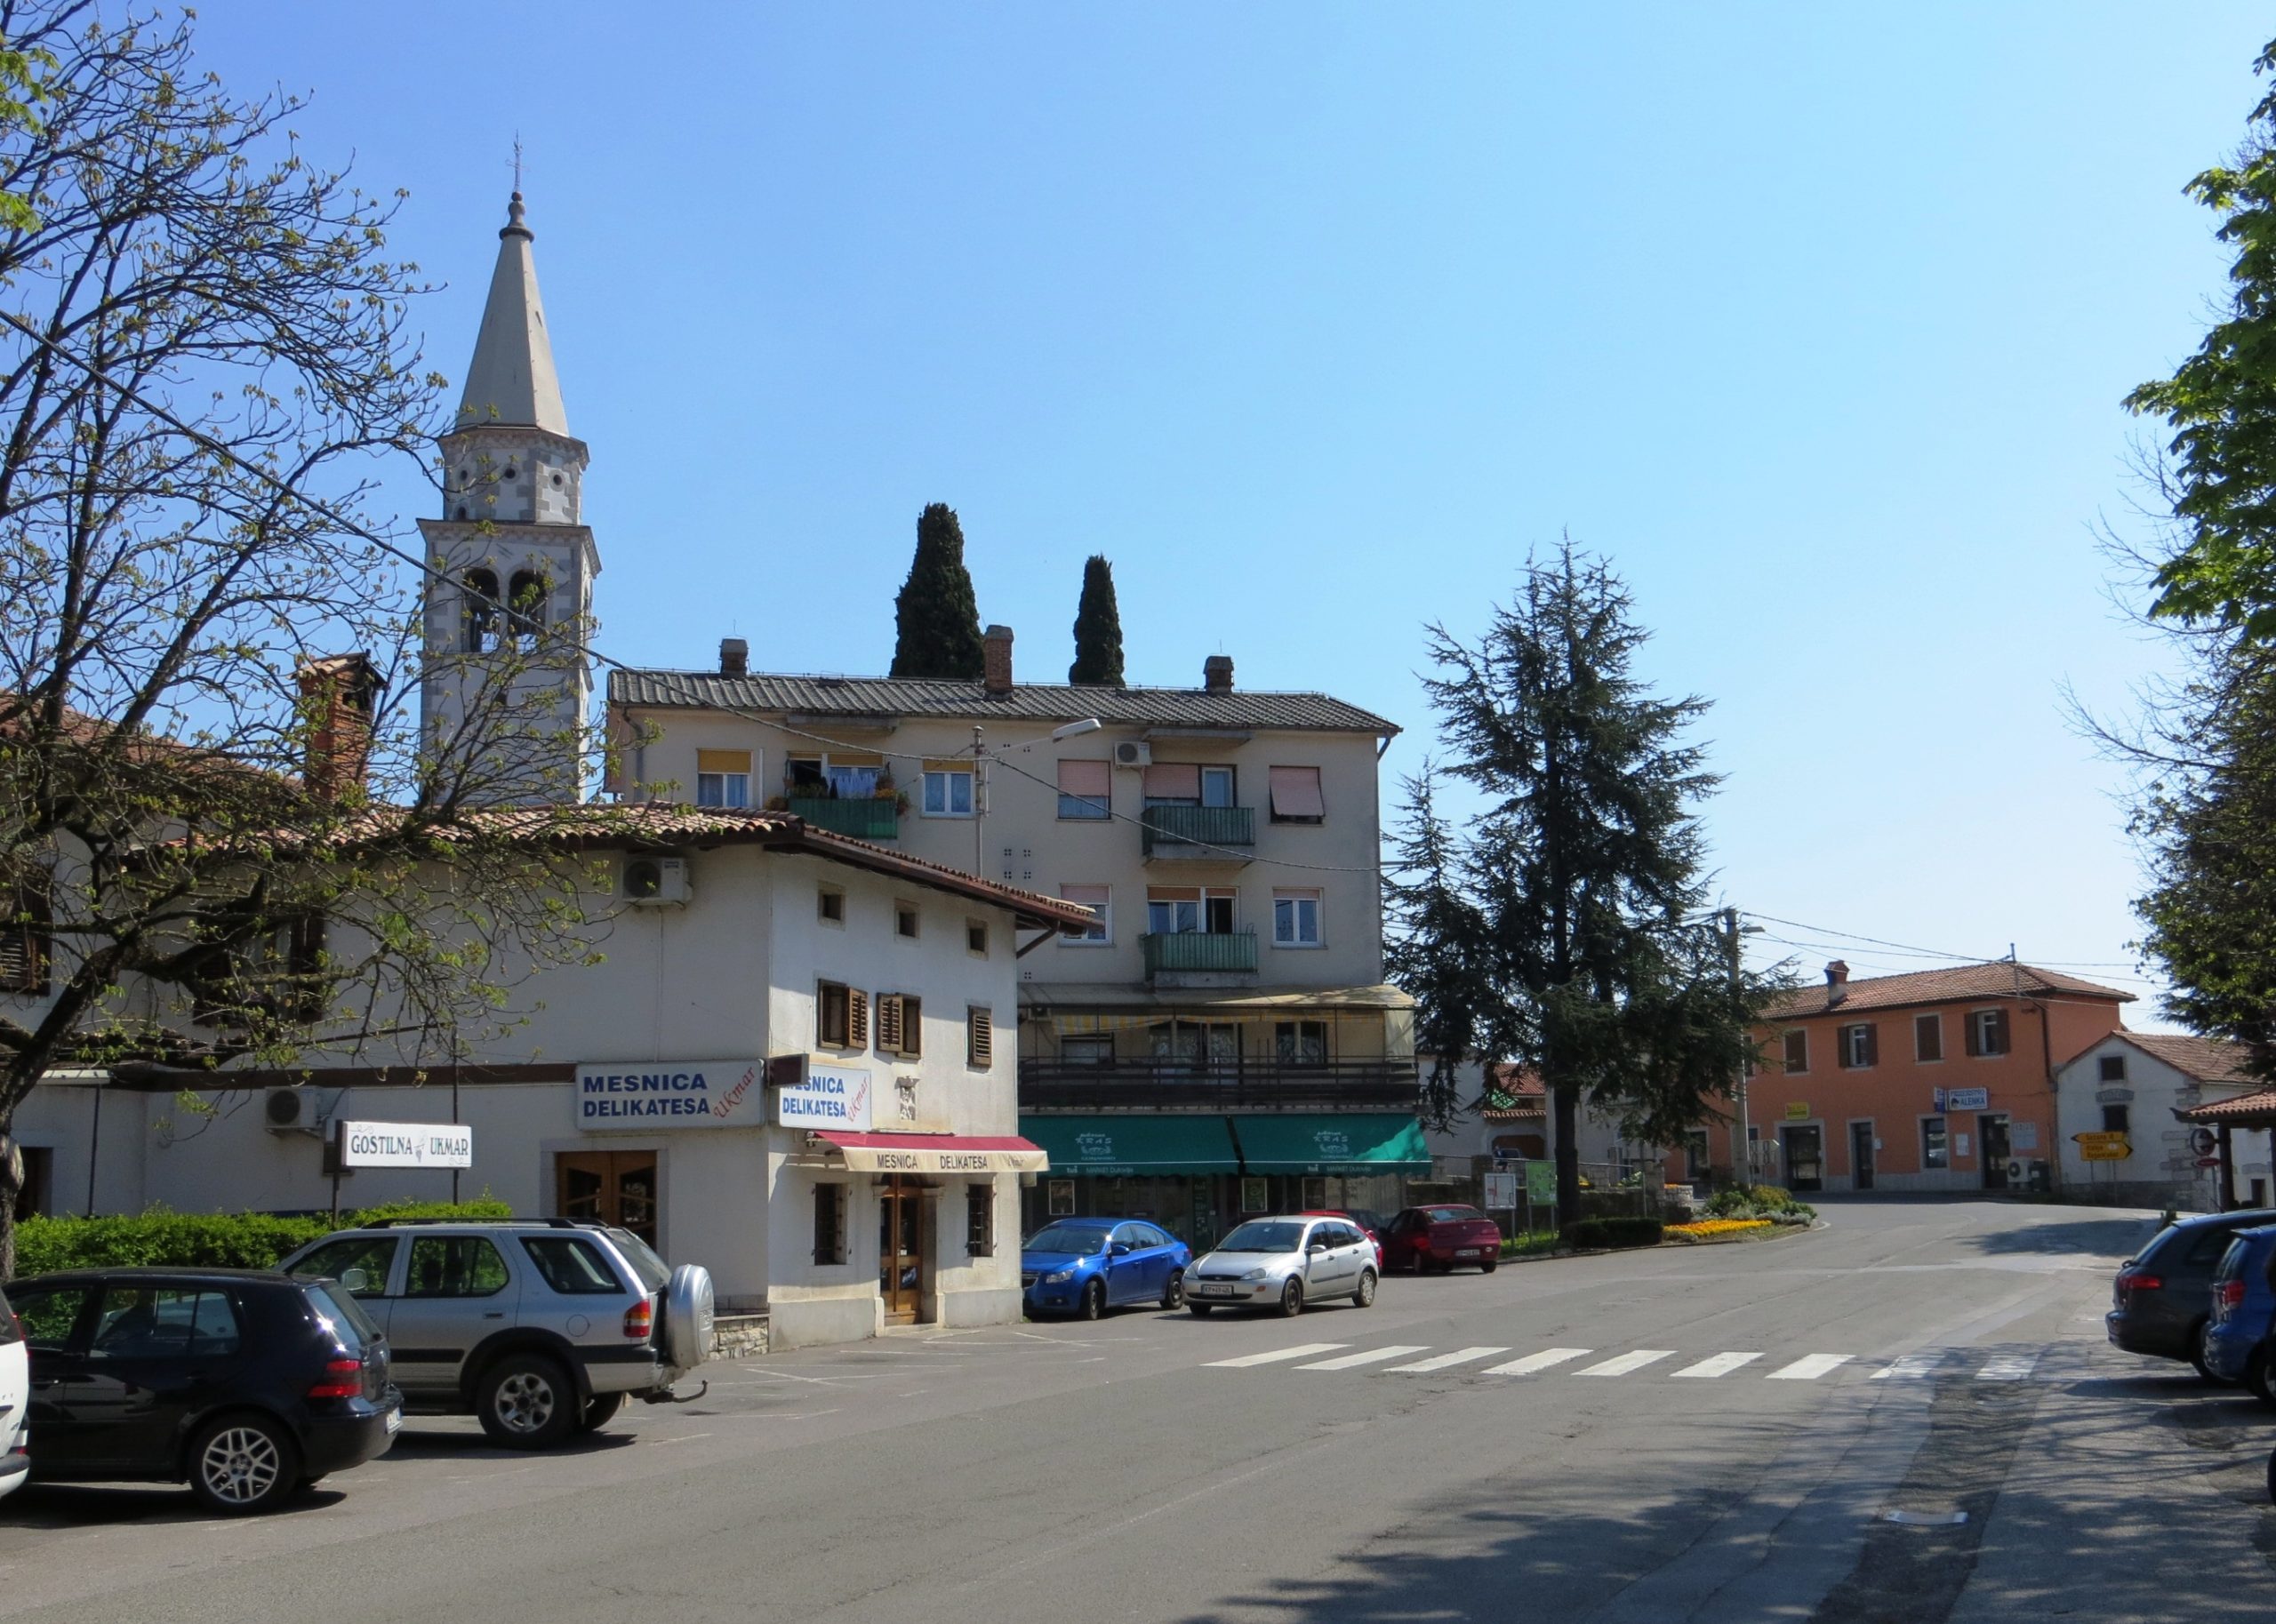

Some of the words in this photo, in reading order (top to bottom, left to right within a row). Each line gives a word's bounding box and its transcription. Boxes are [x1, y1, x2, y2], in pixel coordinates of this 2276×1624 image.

[583, 1073, 708, 1092] MESNICA
[782, 1076, 845, 1095] SNICA
[713, 1066, 757, 1120] Ukmar
[583, 1098, 711, 1117] DELIKATESA
[782, 1096, 847, 1118] DELIKATESA
[351, 1135, 413, 1156] GOSTILNA
[430, 1137, 469, 1156] UKMAR
[877, 1154, 918, 1170] MESNICA
[940, 1155, 988, 1170] DELIKATESA
